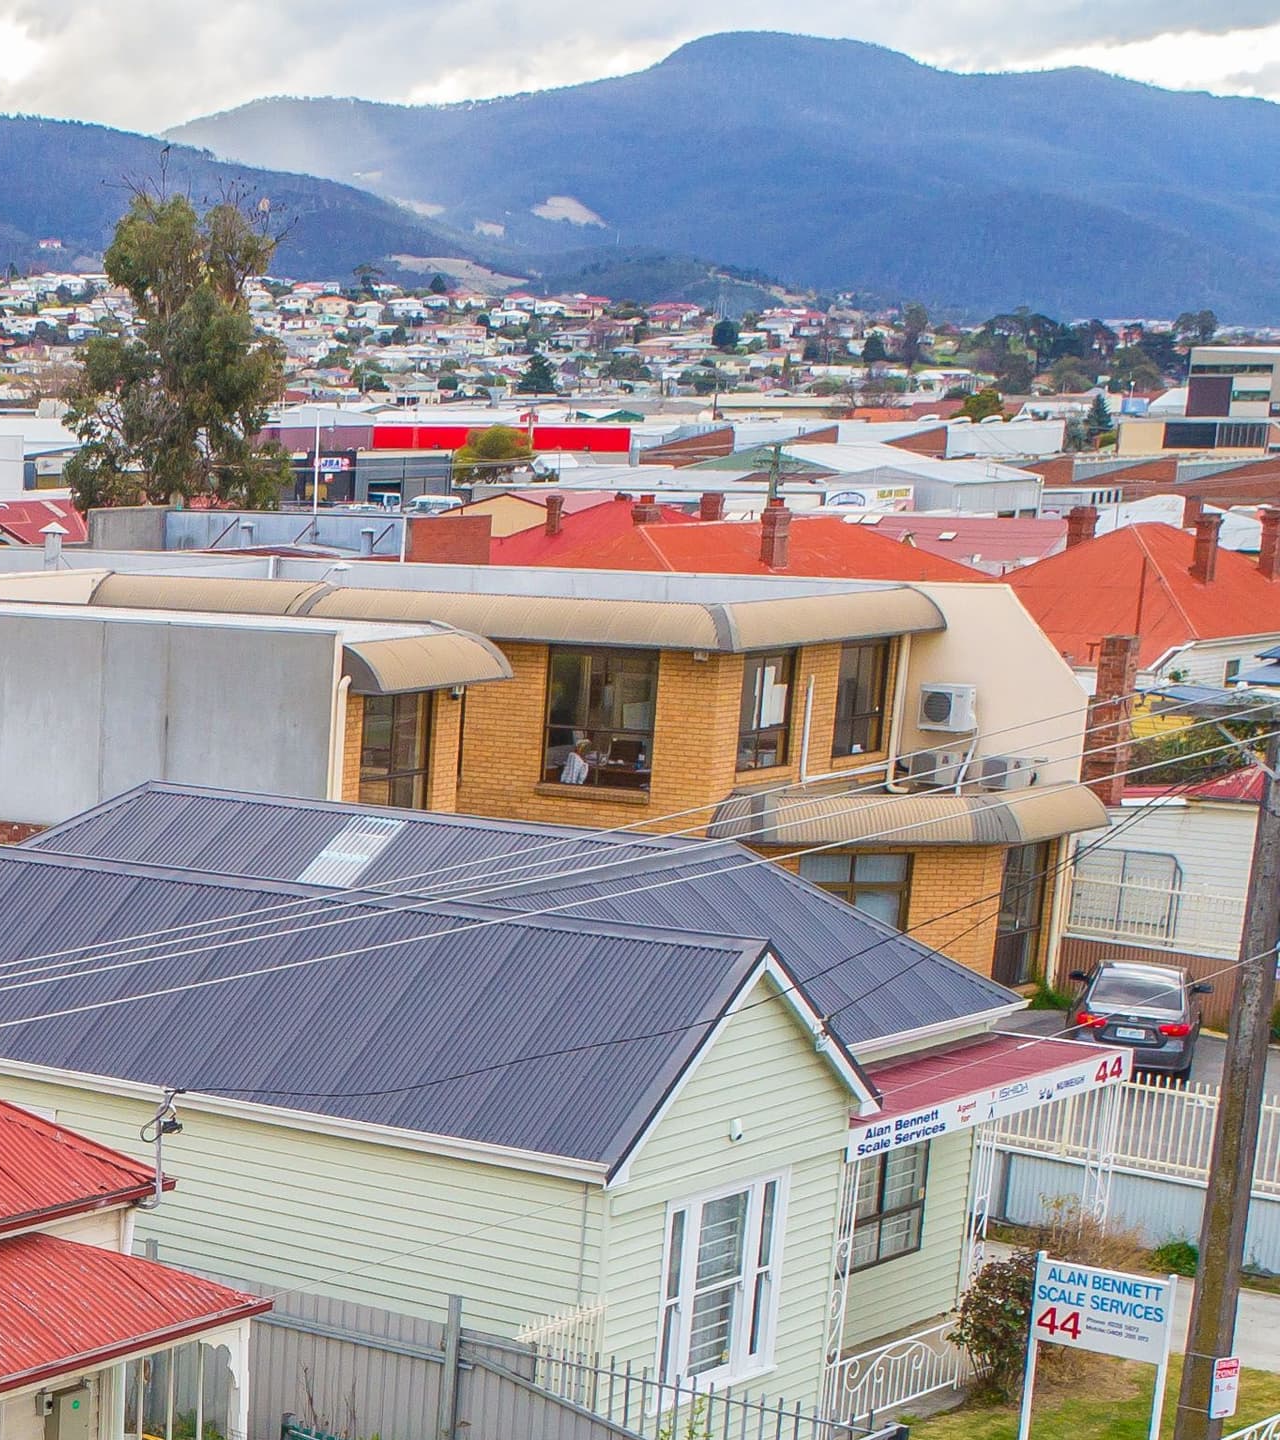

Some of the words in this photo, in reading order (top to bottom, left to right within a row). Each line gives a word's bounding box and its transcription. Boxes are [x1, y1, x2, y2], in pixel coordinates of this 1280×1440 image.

[1094, 1055, 1123, 1083] 44
[857, 1138, 890, 1156] Scale
[894, 1122, 946, 1145] Services
[865, 1124, 891, 1140] Alan
[895, 1109, 939, 1132] Bennett
[1047, 1267, 1088, 1288] ALAN
[1092, 1275, 1163, 1301] BENNETT
[1037, 1285, 1086, 1307] SCALE
[1090, 1295, 1164, 1323] SERVICES
[1037, 1307, 1082, 1340] 44
